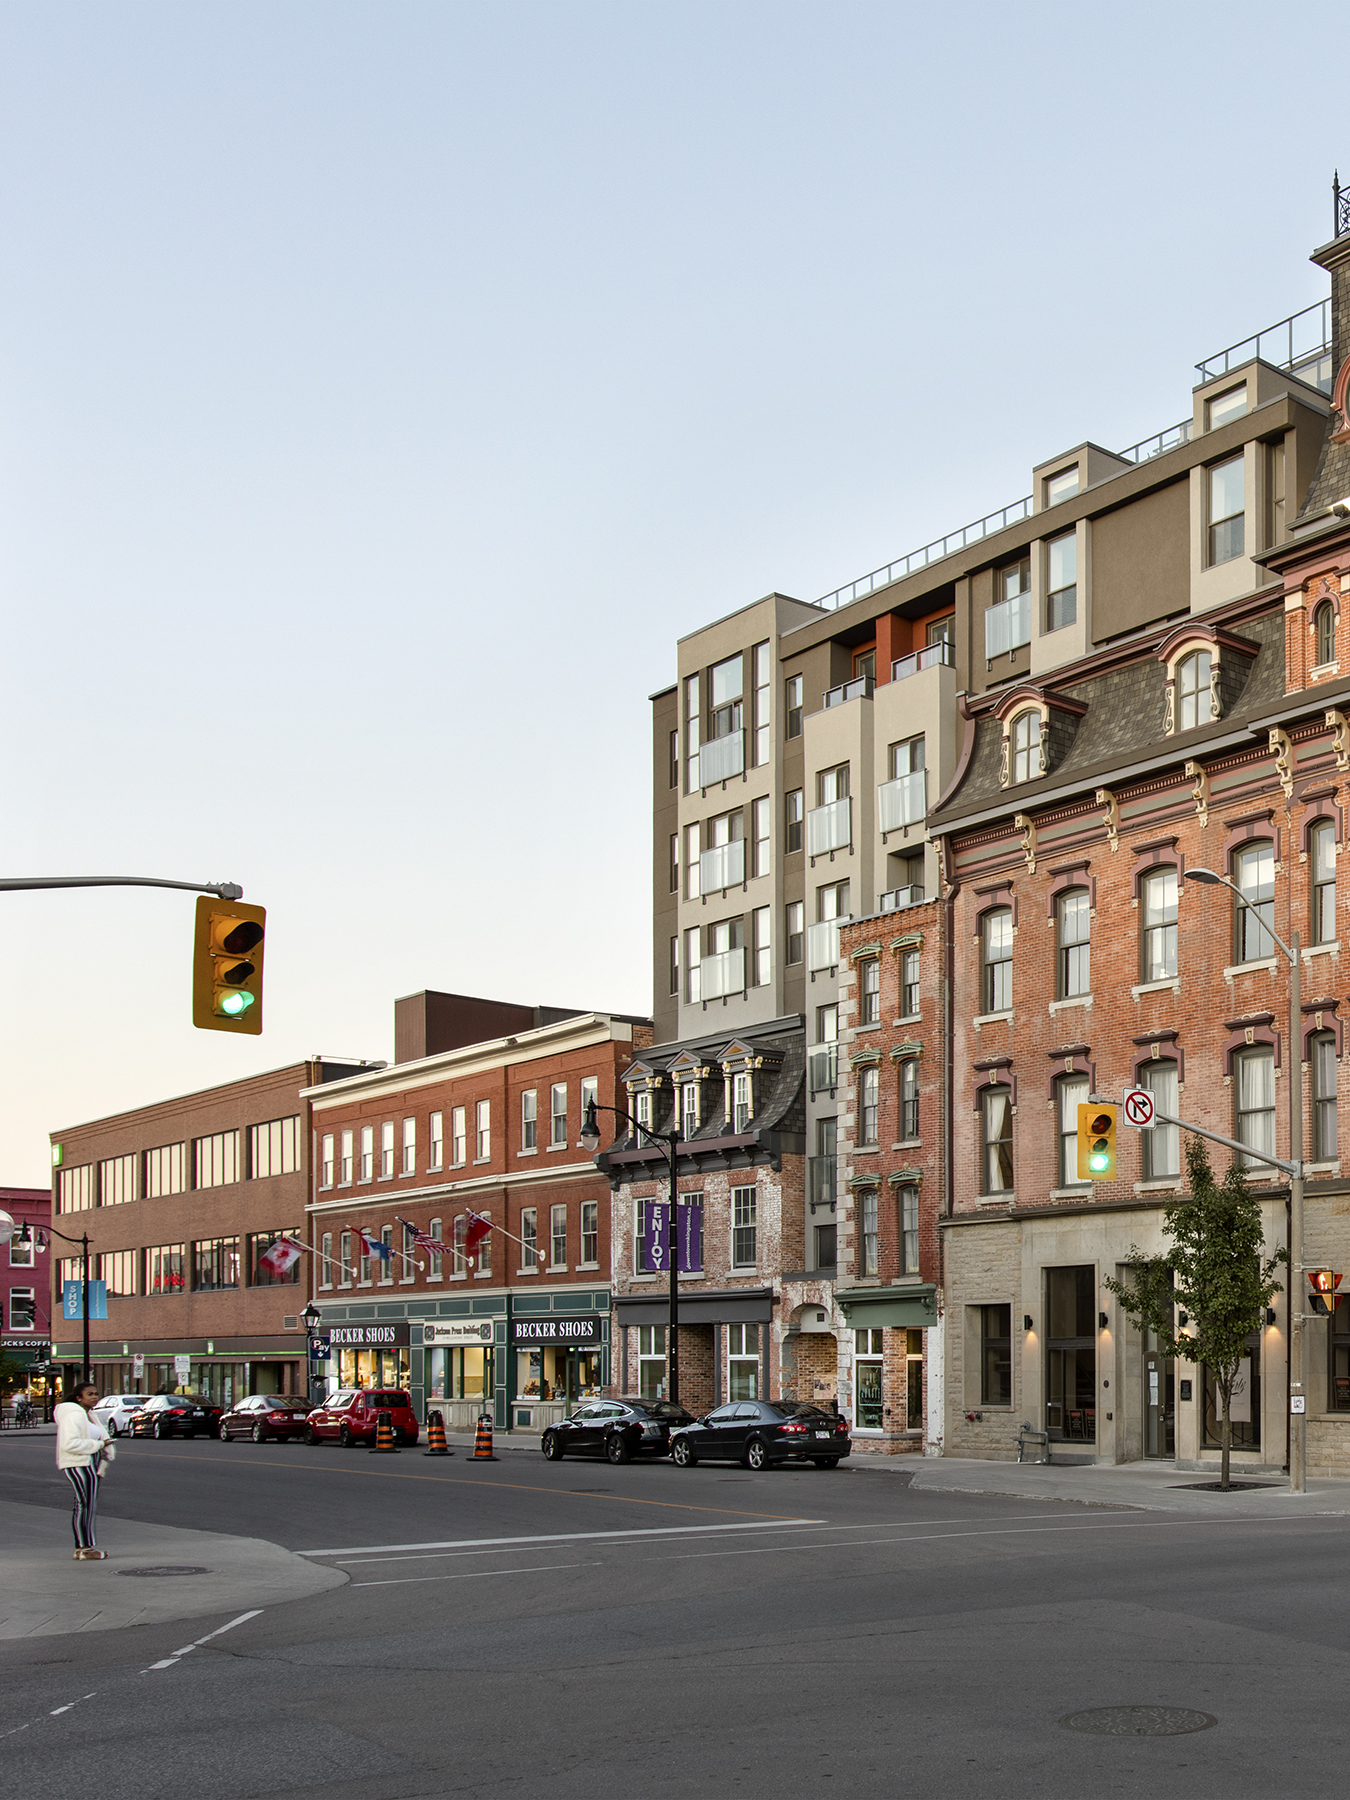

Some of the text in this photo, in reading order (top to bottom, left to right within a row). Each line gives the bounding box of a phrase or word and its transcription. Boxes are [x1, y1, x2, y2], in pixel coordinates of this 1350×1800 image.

[651, 1206, 663, 1269] ENJOY
[68, 1285, 77, 1315] SHOP
[330, 1327, 395, 1343] BECKER SHOES
[516, 1321, 593, 1338] BECKER SHOES
[313, 1339, 330, 1353] Pay
